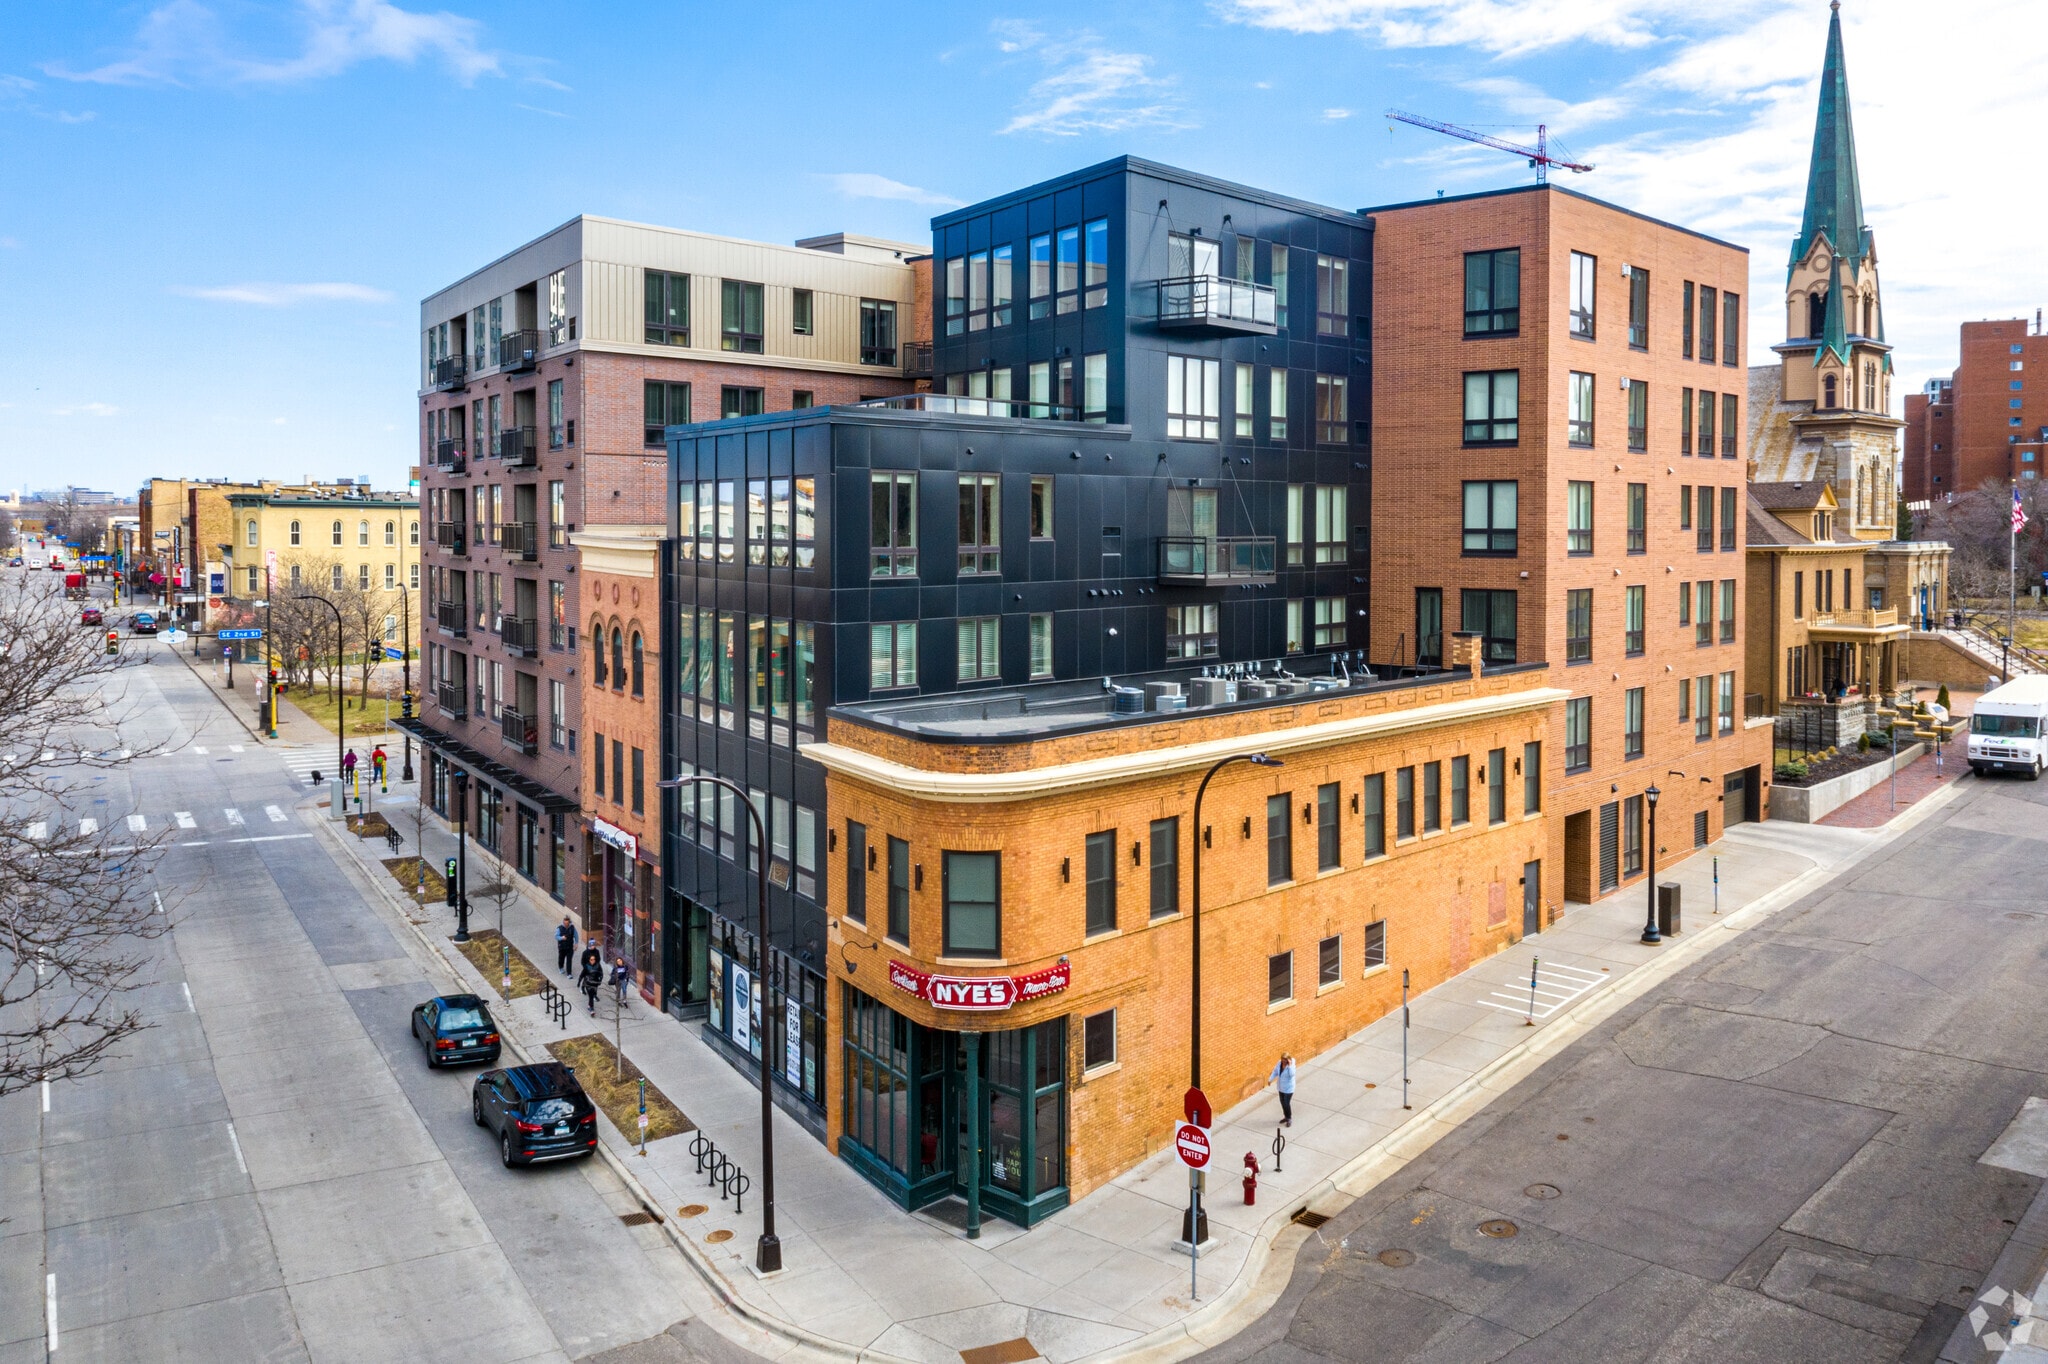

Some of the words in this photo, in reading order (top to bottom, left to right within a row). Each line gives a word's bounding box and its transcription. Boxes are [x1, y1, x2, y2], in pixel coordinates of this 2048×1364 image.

[936, 981, 1006, 1004] NYE'S
[790, 1018, 799, 1033] FOR
[1181, 1131, 1190, 1140] DO
[1192, 1134, 1205, 1145] NOT
[1183, 1148, 1203, 1161] ENTER
